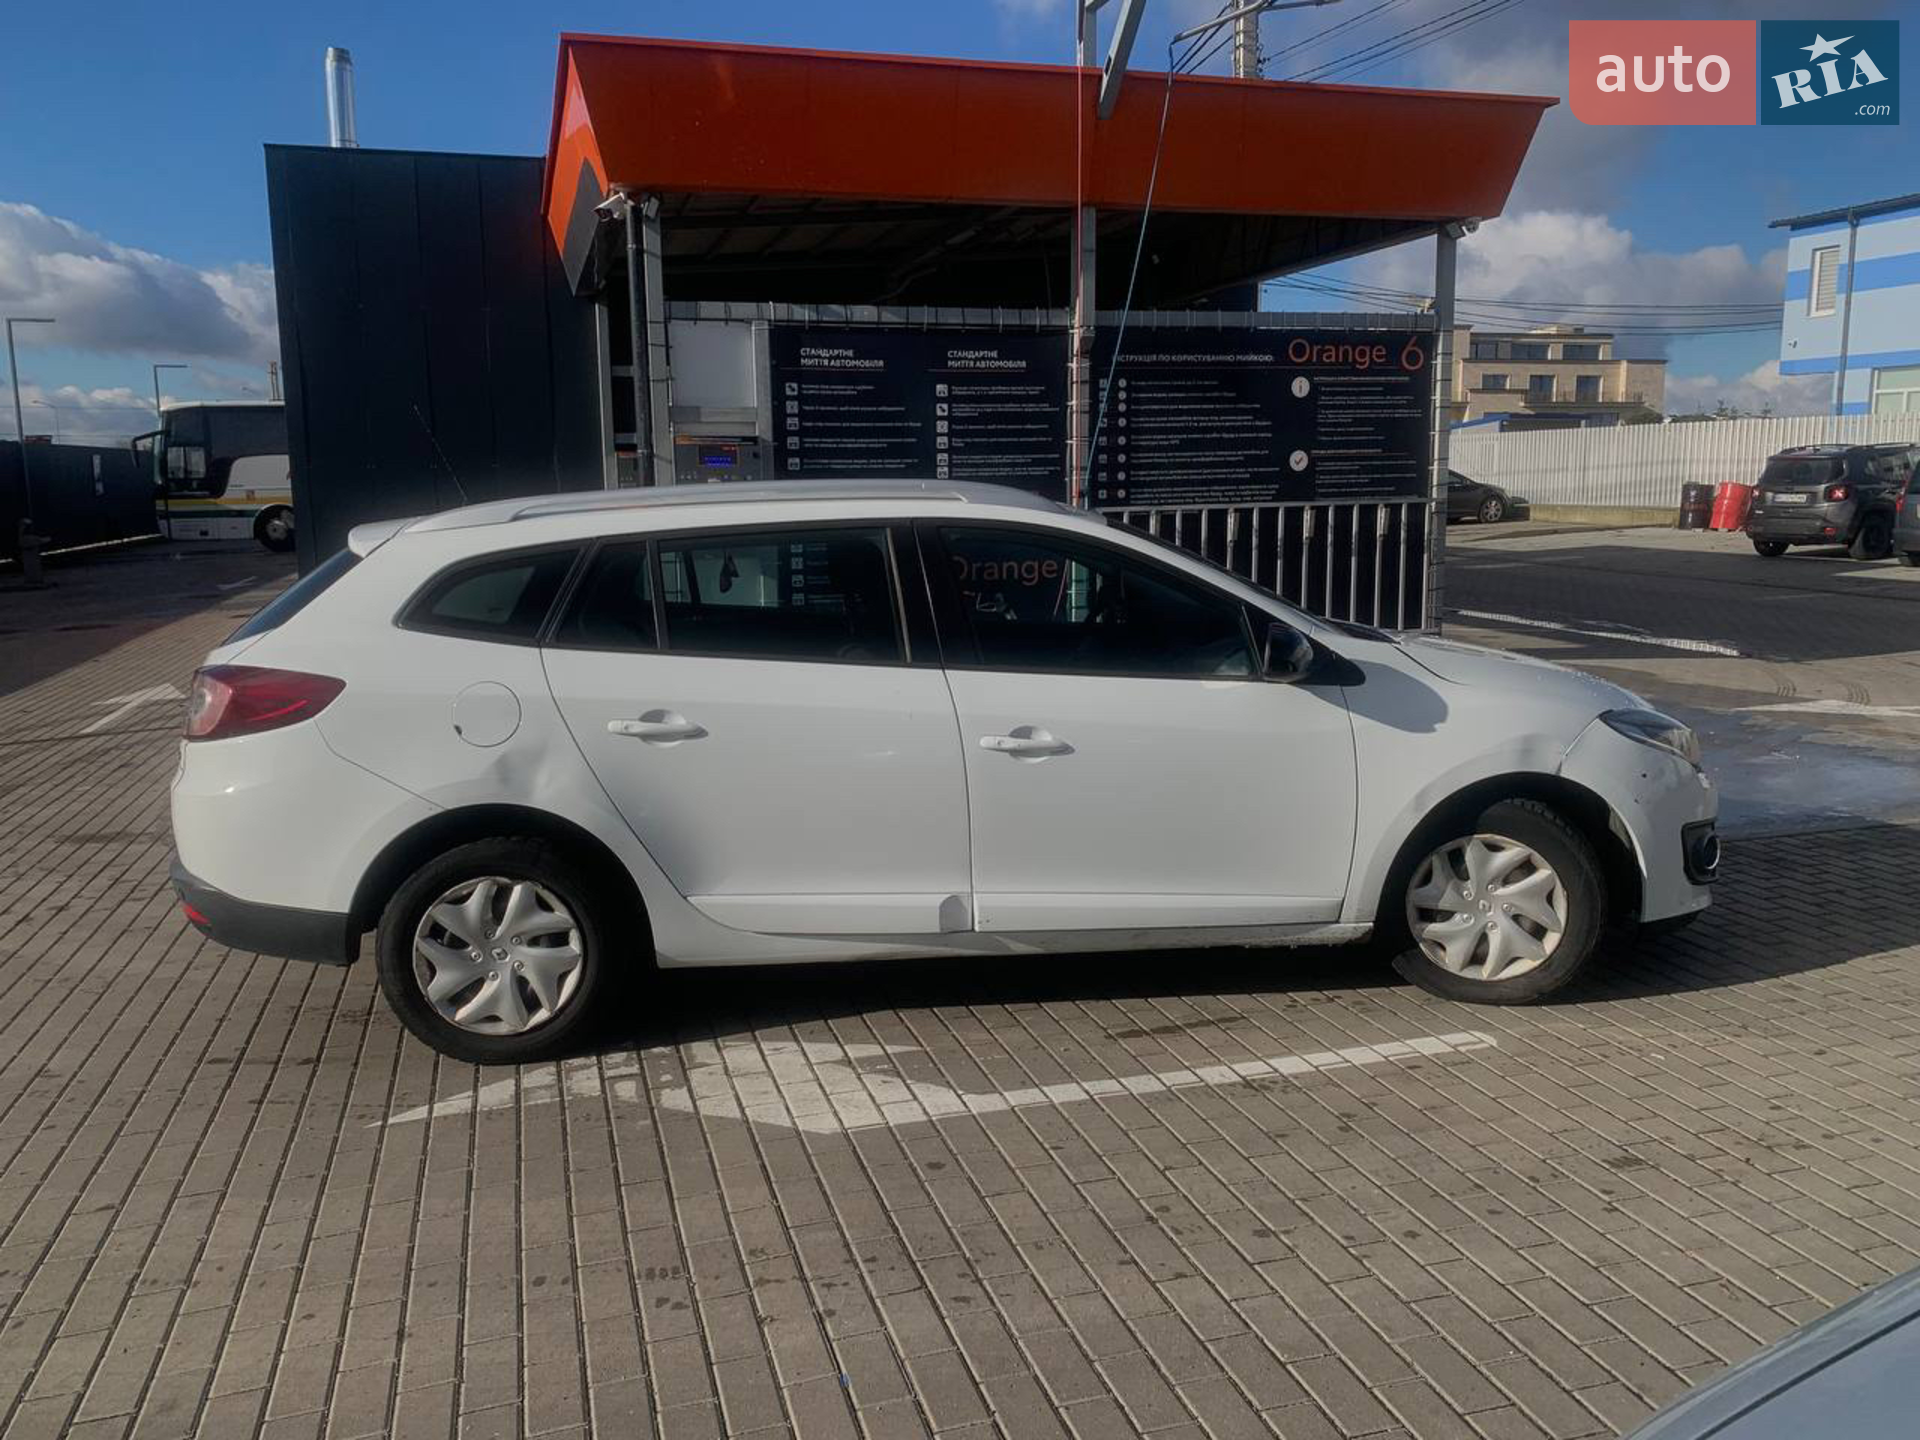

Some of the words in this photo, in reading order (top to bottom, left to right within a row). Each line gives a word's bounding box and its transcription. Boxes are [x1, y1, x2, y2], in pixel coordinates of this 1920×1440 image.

[800, 347, 854, 357] СТАНДАРТНЕ
[947, 350, 999, 359] СТАНДАРТНЕ
[1288, 338, 1387, 369] Orange
[1401, 336, 1424, 370] 6
